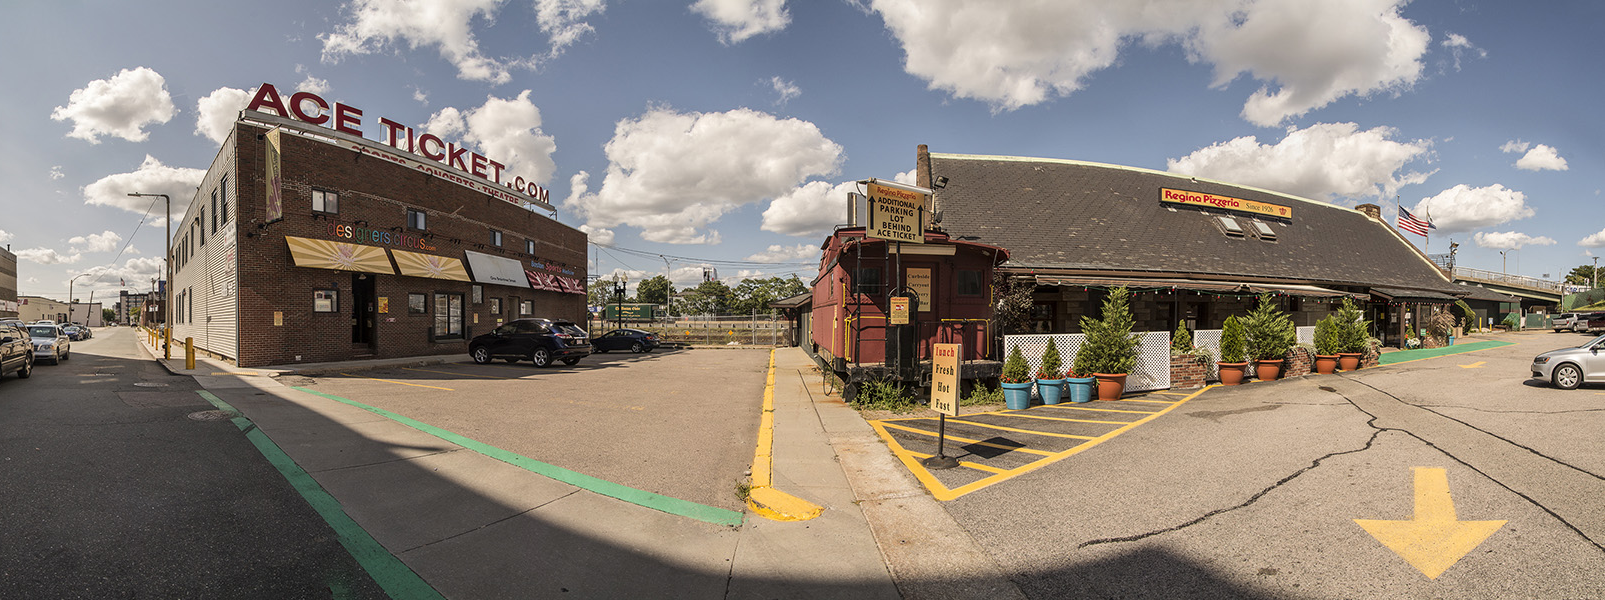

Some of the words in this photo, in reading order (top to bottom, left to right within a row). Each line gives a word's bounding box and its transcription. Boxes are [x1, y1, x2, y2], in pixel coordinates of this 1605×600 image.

[246, 82, 363, 138] ACE
[378, 116, 550, 204] TICKET.COM
[482, 186, 519, 204] THEATRE
[1165, 190, 1202, 202] Regina
[1203, 194, 1240, 208] Pizzeria
[1245, 203, 1261, 211] Since
[878, 197, 916, 210] ADDITIONAL
[880, 205, 914, 217] PARKING
[890, 215, 904, 223] LOT
[882, 221, 912, 232] BEHIND
[327, 219, 391, 244] designers
[394, 233, 436, 251] circus.com
[877, 229, 891, 237] ACE
[892, 231, 917, 240] TICKET
[545, 262, 562, 273] Sports
[935, 363, 954, 376] Fresh
[937, 381, 950, 393] Hot
[935, 398, 950, 411] Fast
